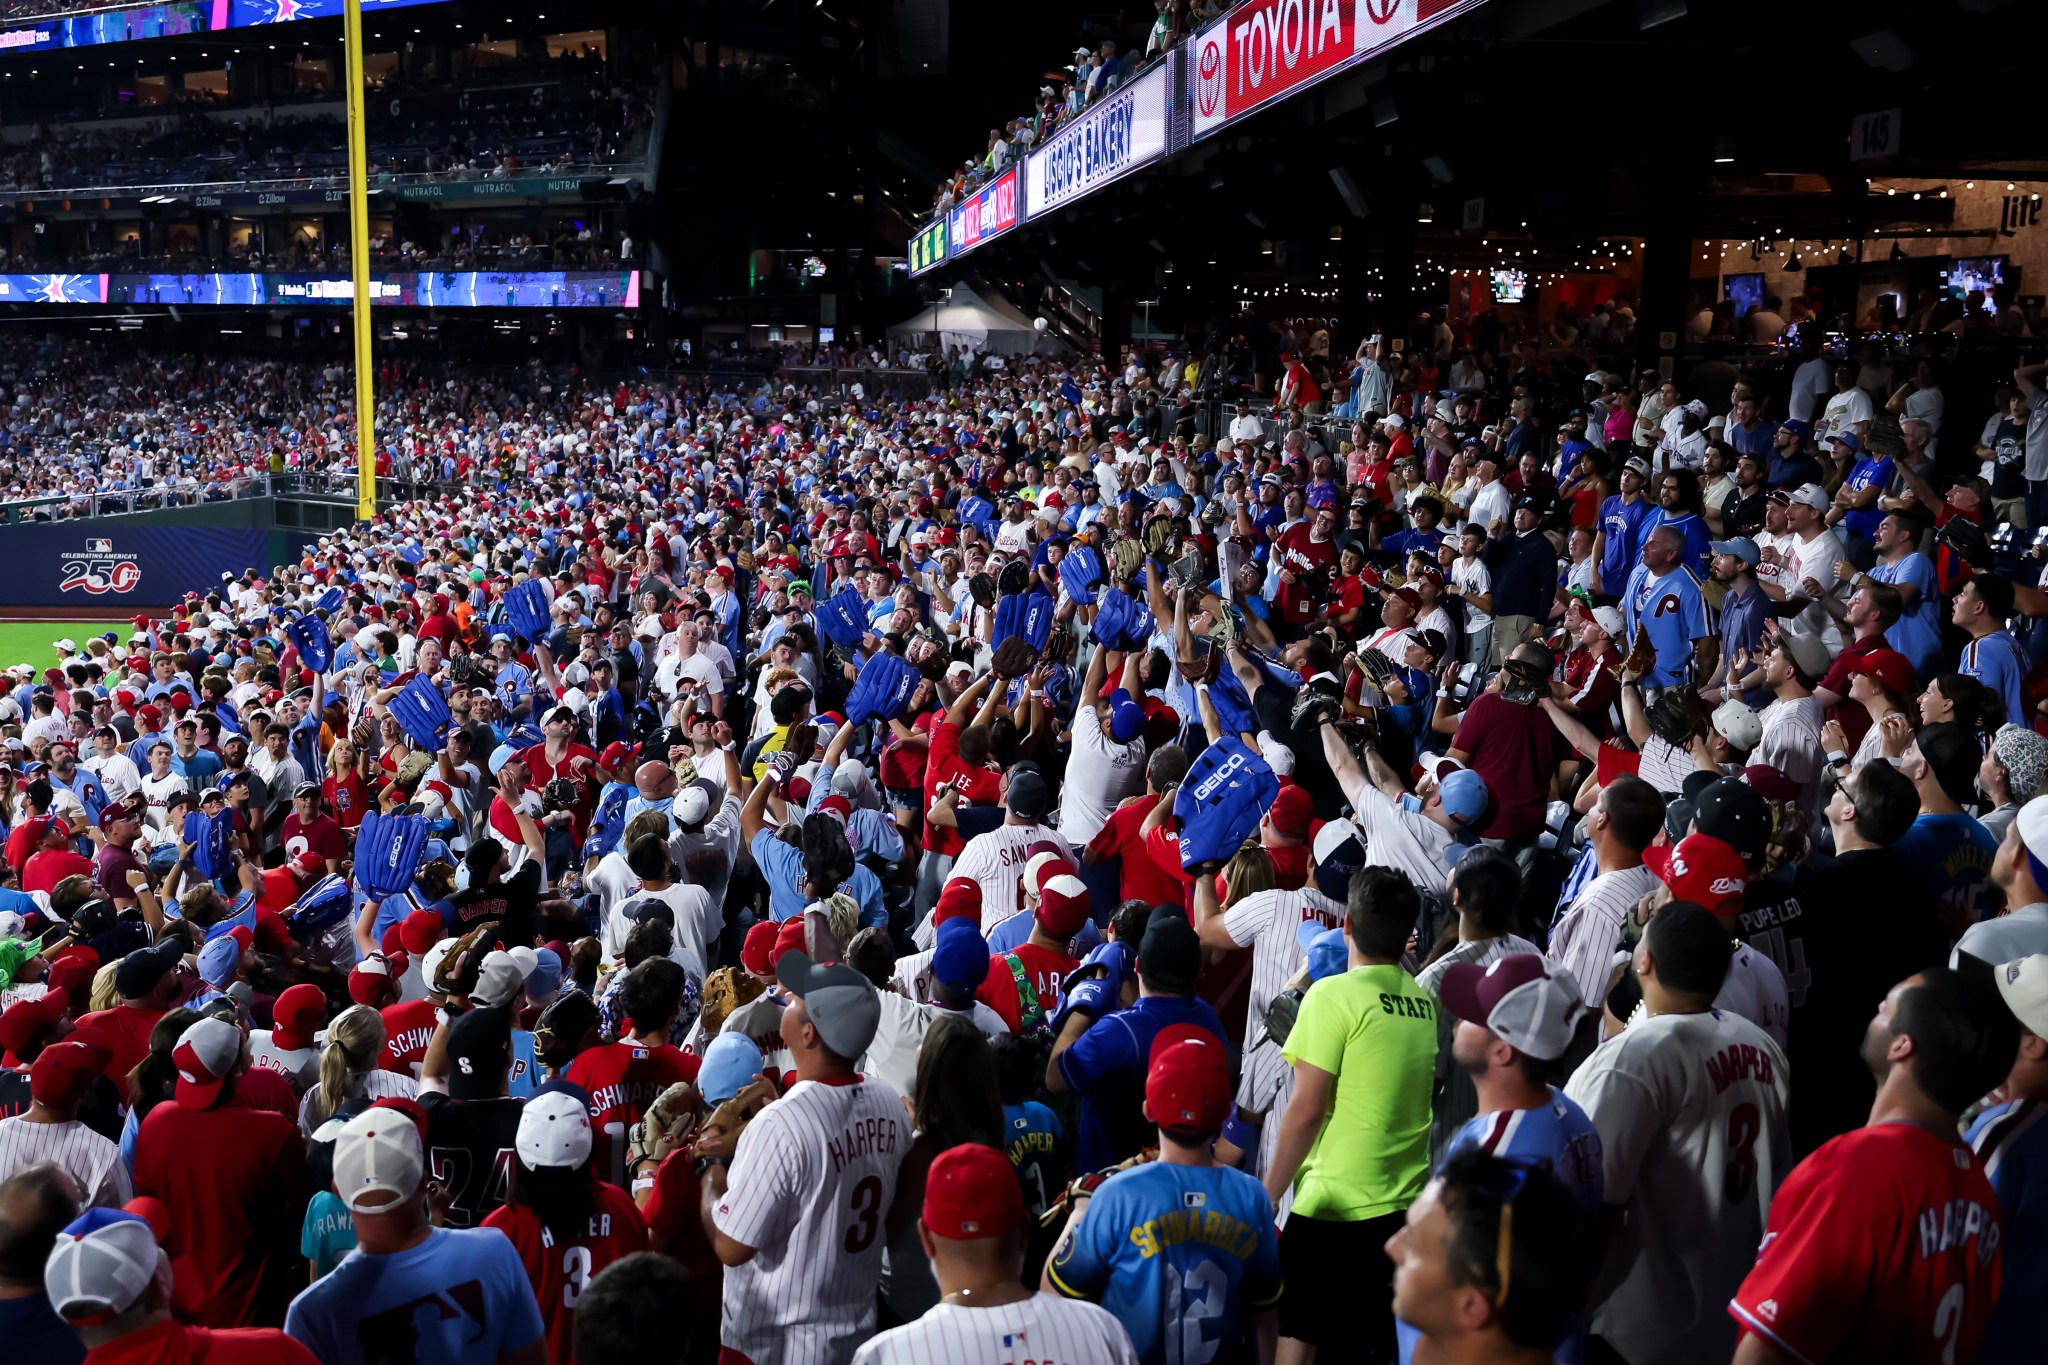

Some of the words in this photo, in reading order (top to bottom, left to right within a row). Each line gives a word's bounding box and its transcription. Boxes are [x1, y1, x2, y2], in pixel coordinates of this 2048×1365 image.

[1235, 0, 1341, 96] TOYOTA
[1085, 91, 1134, 183] BAKERY
[1862, 115, 1890, 154] 145
[202, 196, 221, 206] Zillow
[265, 194, 285, 204] Zillow
[404, 186, 443, 197] NUTRAFOL
[474, 182, 515, 193] NUTRAFOL
[548, 180, 581, 190] NUTRAF
[997, 178, 1015, 225] NECA
[2000, 195, 2043, 238] Lite
[1285, 547, 1315, 572] phillie
[1466, 579, 1478, 592] NY
[1026, 607, 1038, 636] GEICO
[414, 690, 431, 712] GEICO
[897, 674, 910, 702] GEICO
[1193, 753, 1245, 801] GEICO
[388, 835, 403, 868] GEICO
[459, 899, 508, 923] HARPER
[1739, 905, 1780, 932] POPE
[1777, 897, 1802, 923] LEO
[1038, 971, 1060, 997] AR
[1379, 993, 1433, 1021] STAFF
[388, 1026, 433, 1058] SCHW
[458, 1056, 474, 1075] S
[1706, 1043, 1773, 1095] HARPER
[603, 1121, 625, 1185] 1
[828, 1117, 896, 1172] HARPER
[1007, 1132, 1054, 1167] HARPER
[1725, 1103, 1760, 1205] 3
[431, 1146, 516, 1227] 24
[541, 1213, 612, 1249] HER
[844, 1175, 883, 1254] 3
[1129, 1207, 1260, 1260] SCHWARBER
[1919, 1197, 2001, 1269] HARPER
[562, 1245, 592, 1309] 3
[1164, 1259, 1228, 1365] 12
